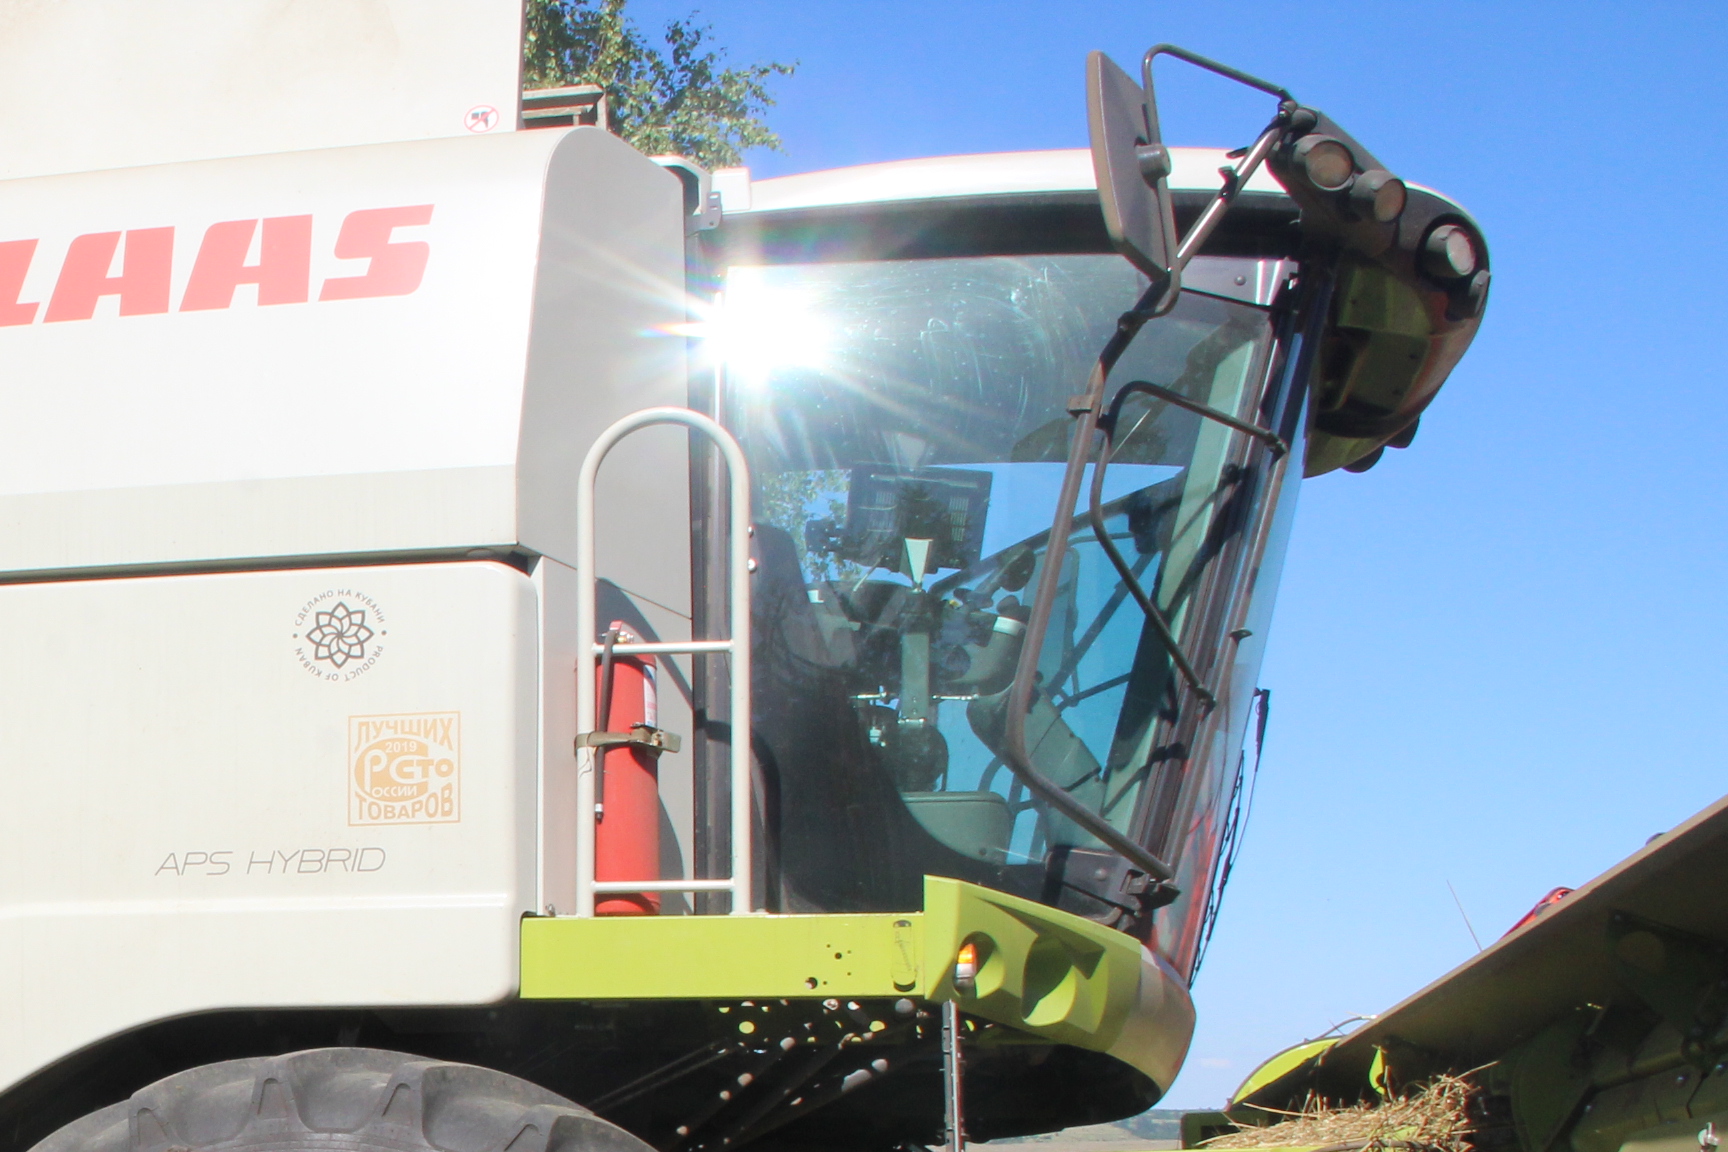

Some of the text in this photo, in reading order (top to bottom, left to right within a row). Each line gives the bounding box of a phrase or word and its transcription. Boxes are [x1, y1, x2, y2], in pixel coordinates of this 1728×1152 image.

[295, 589, 385, 627] СДЕЛАНО НА КУБАНИ
[295, 645, 384, 682] PRODUCT OF KUBAN
[354, 717, 454, 754] ЛУЧШИХ
[385, 741, 417, 753] 2019
[354, 782, 454, 820] ТОВАРОВ
[154, 847, 386, 876] APS HYBRID
